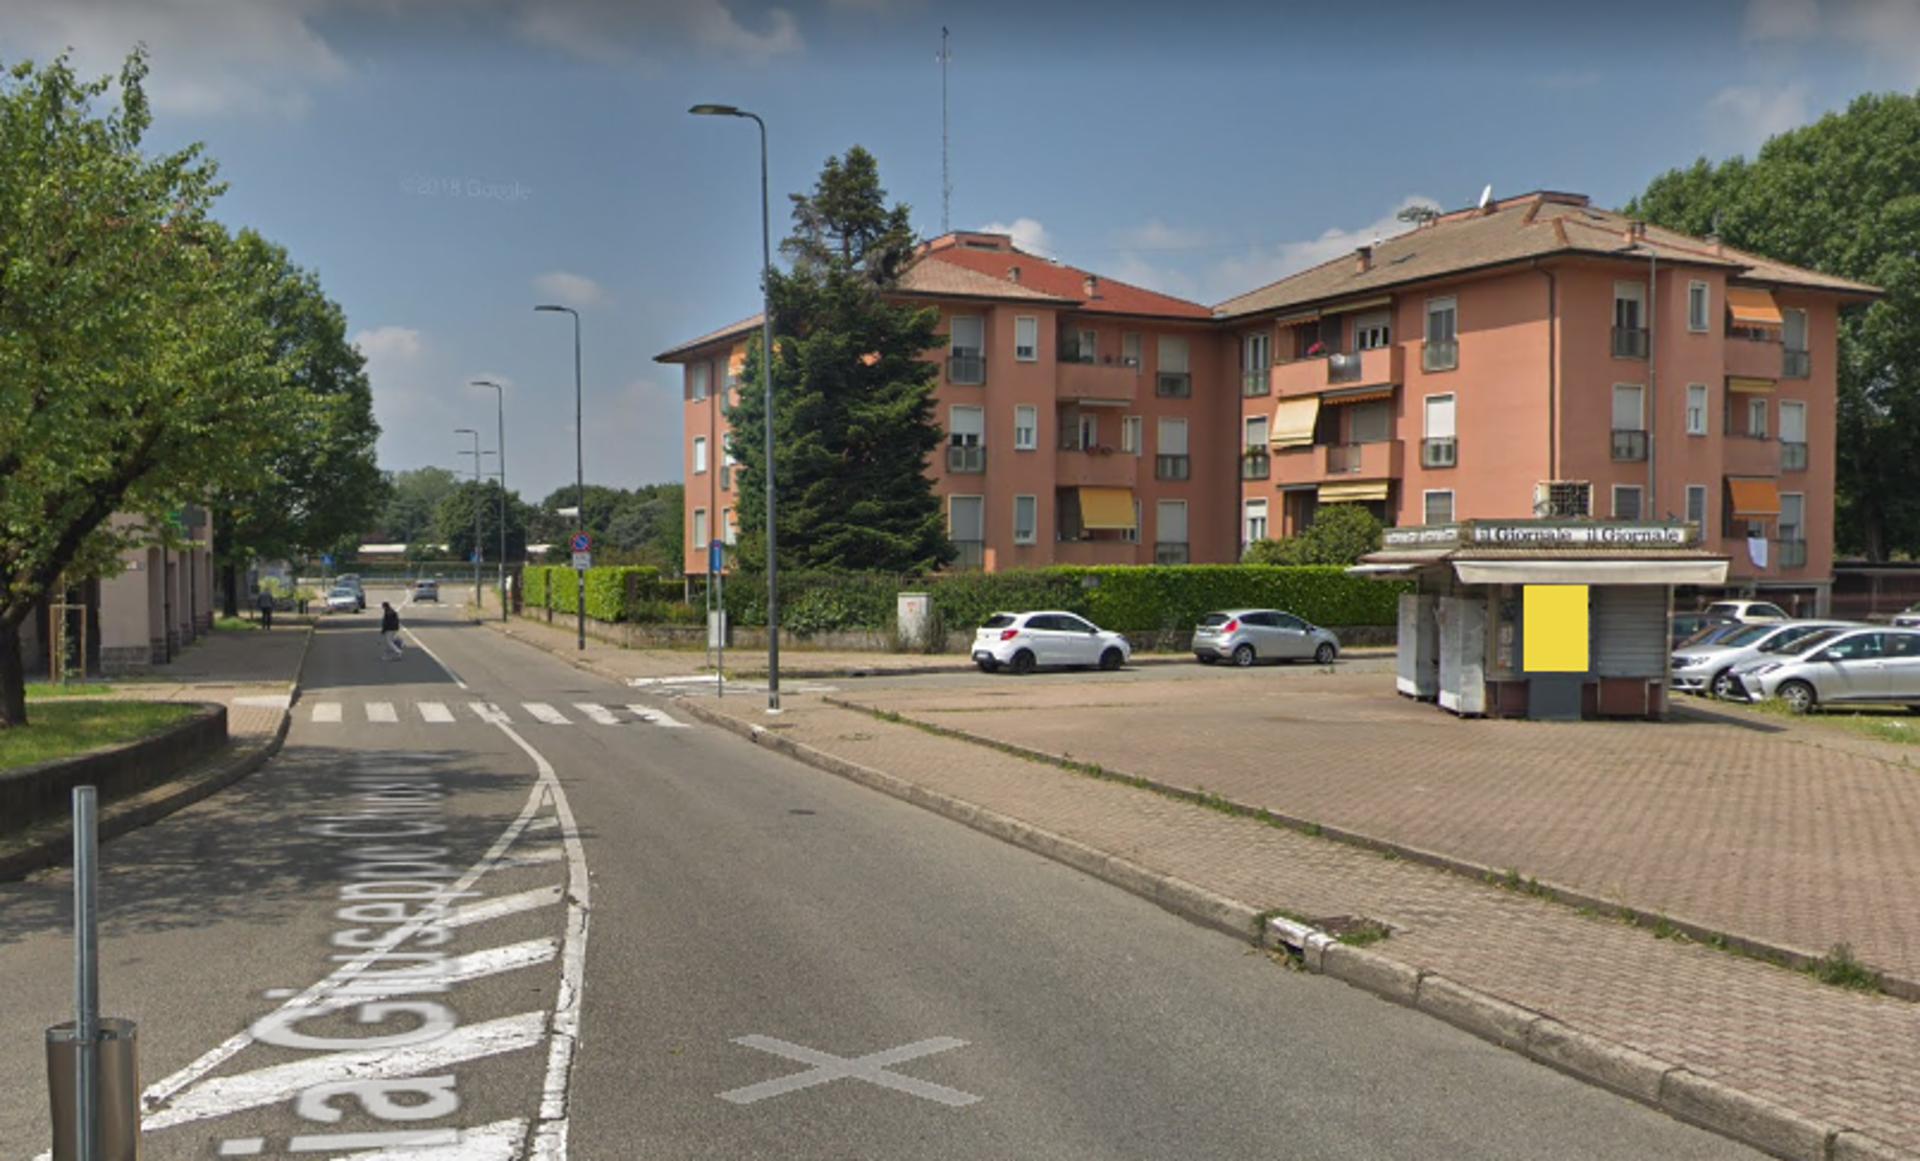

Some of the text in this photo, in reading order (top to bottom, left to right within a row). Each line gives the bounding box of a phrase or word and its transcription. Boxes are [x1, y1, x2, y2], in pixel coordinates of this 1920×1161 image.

[1496, 526, 1573, 542] Giornale
[1587, 526, 1679, 542] il Giornale
